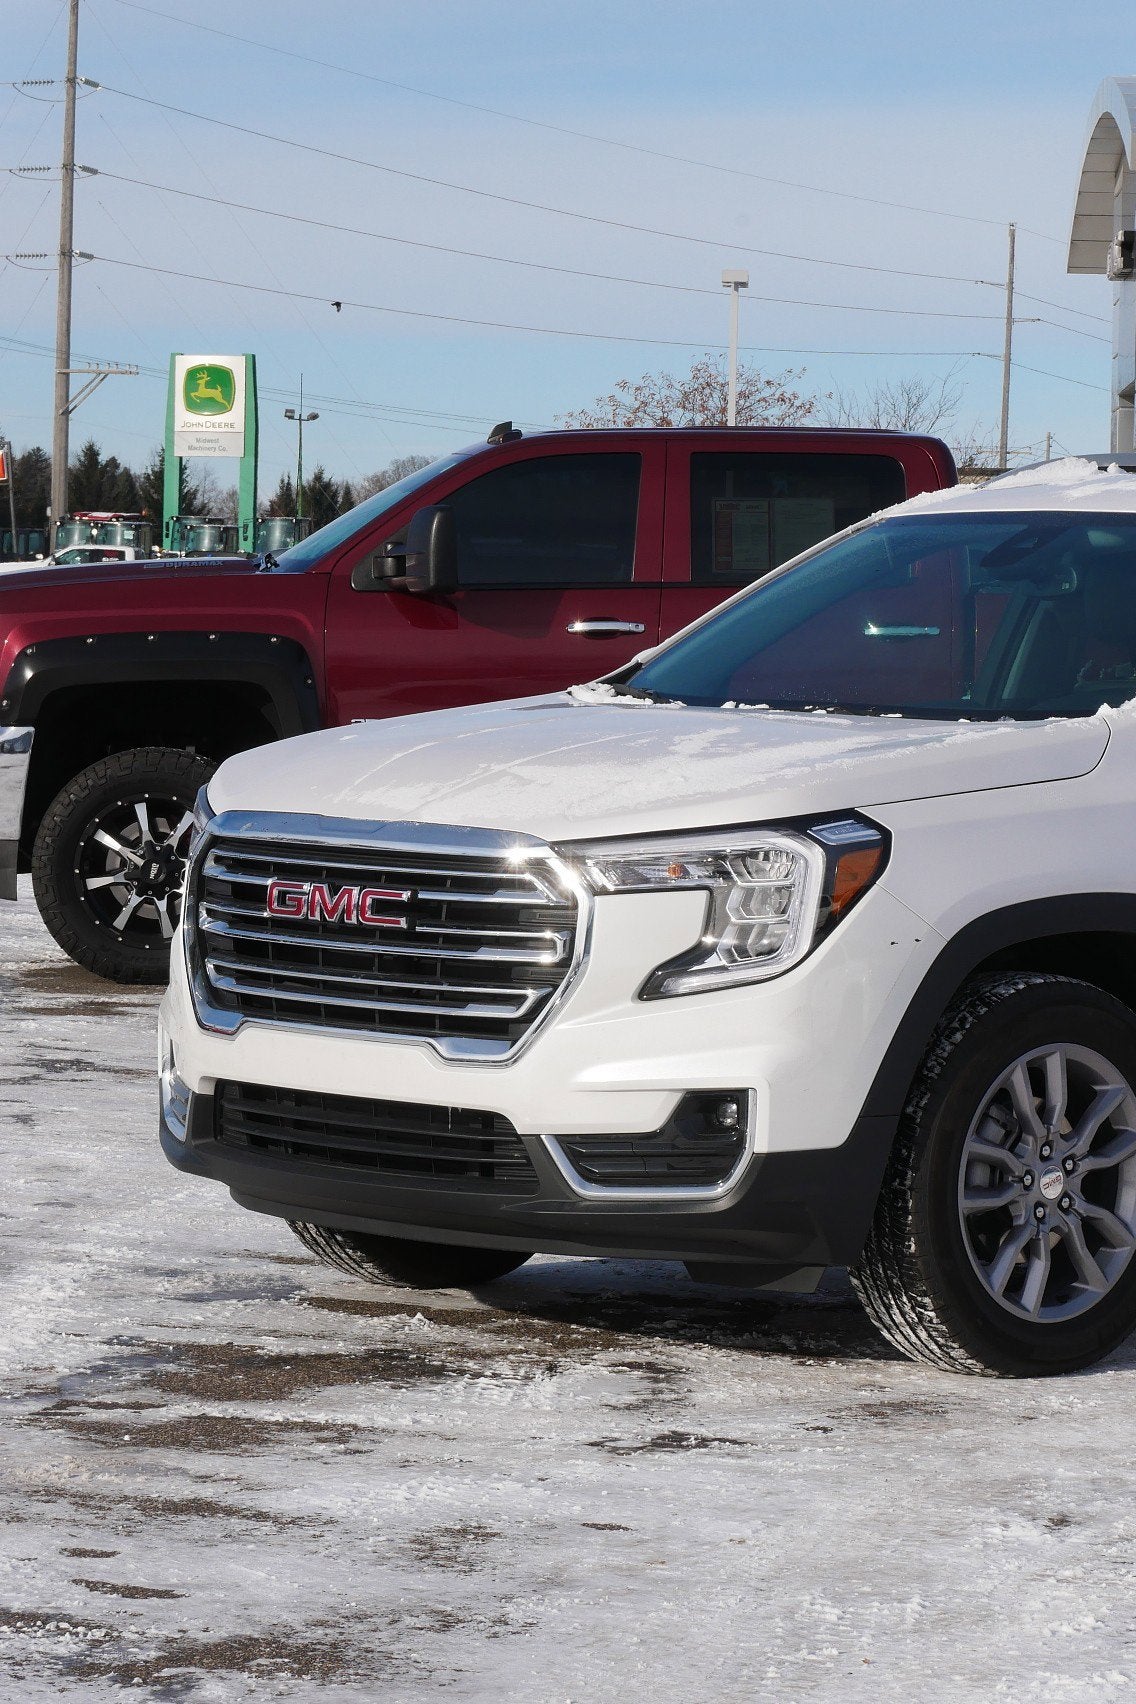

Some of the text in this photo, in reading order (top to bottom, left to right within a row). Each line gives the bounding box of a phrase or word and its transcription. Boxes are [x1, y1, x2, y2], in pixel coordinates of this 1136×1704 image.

[181, 420, 235, 429] JOHN DEERE
[165, 560, 224, 568] DURAMAX
[267, 877, 412, 929] GMC
